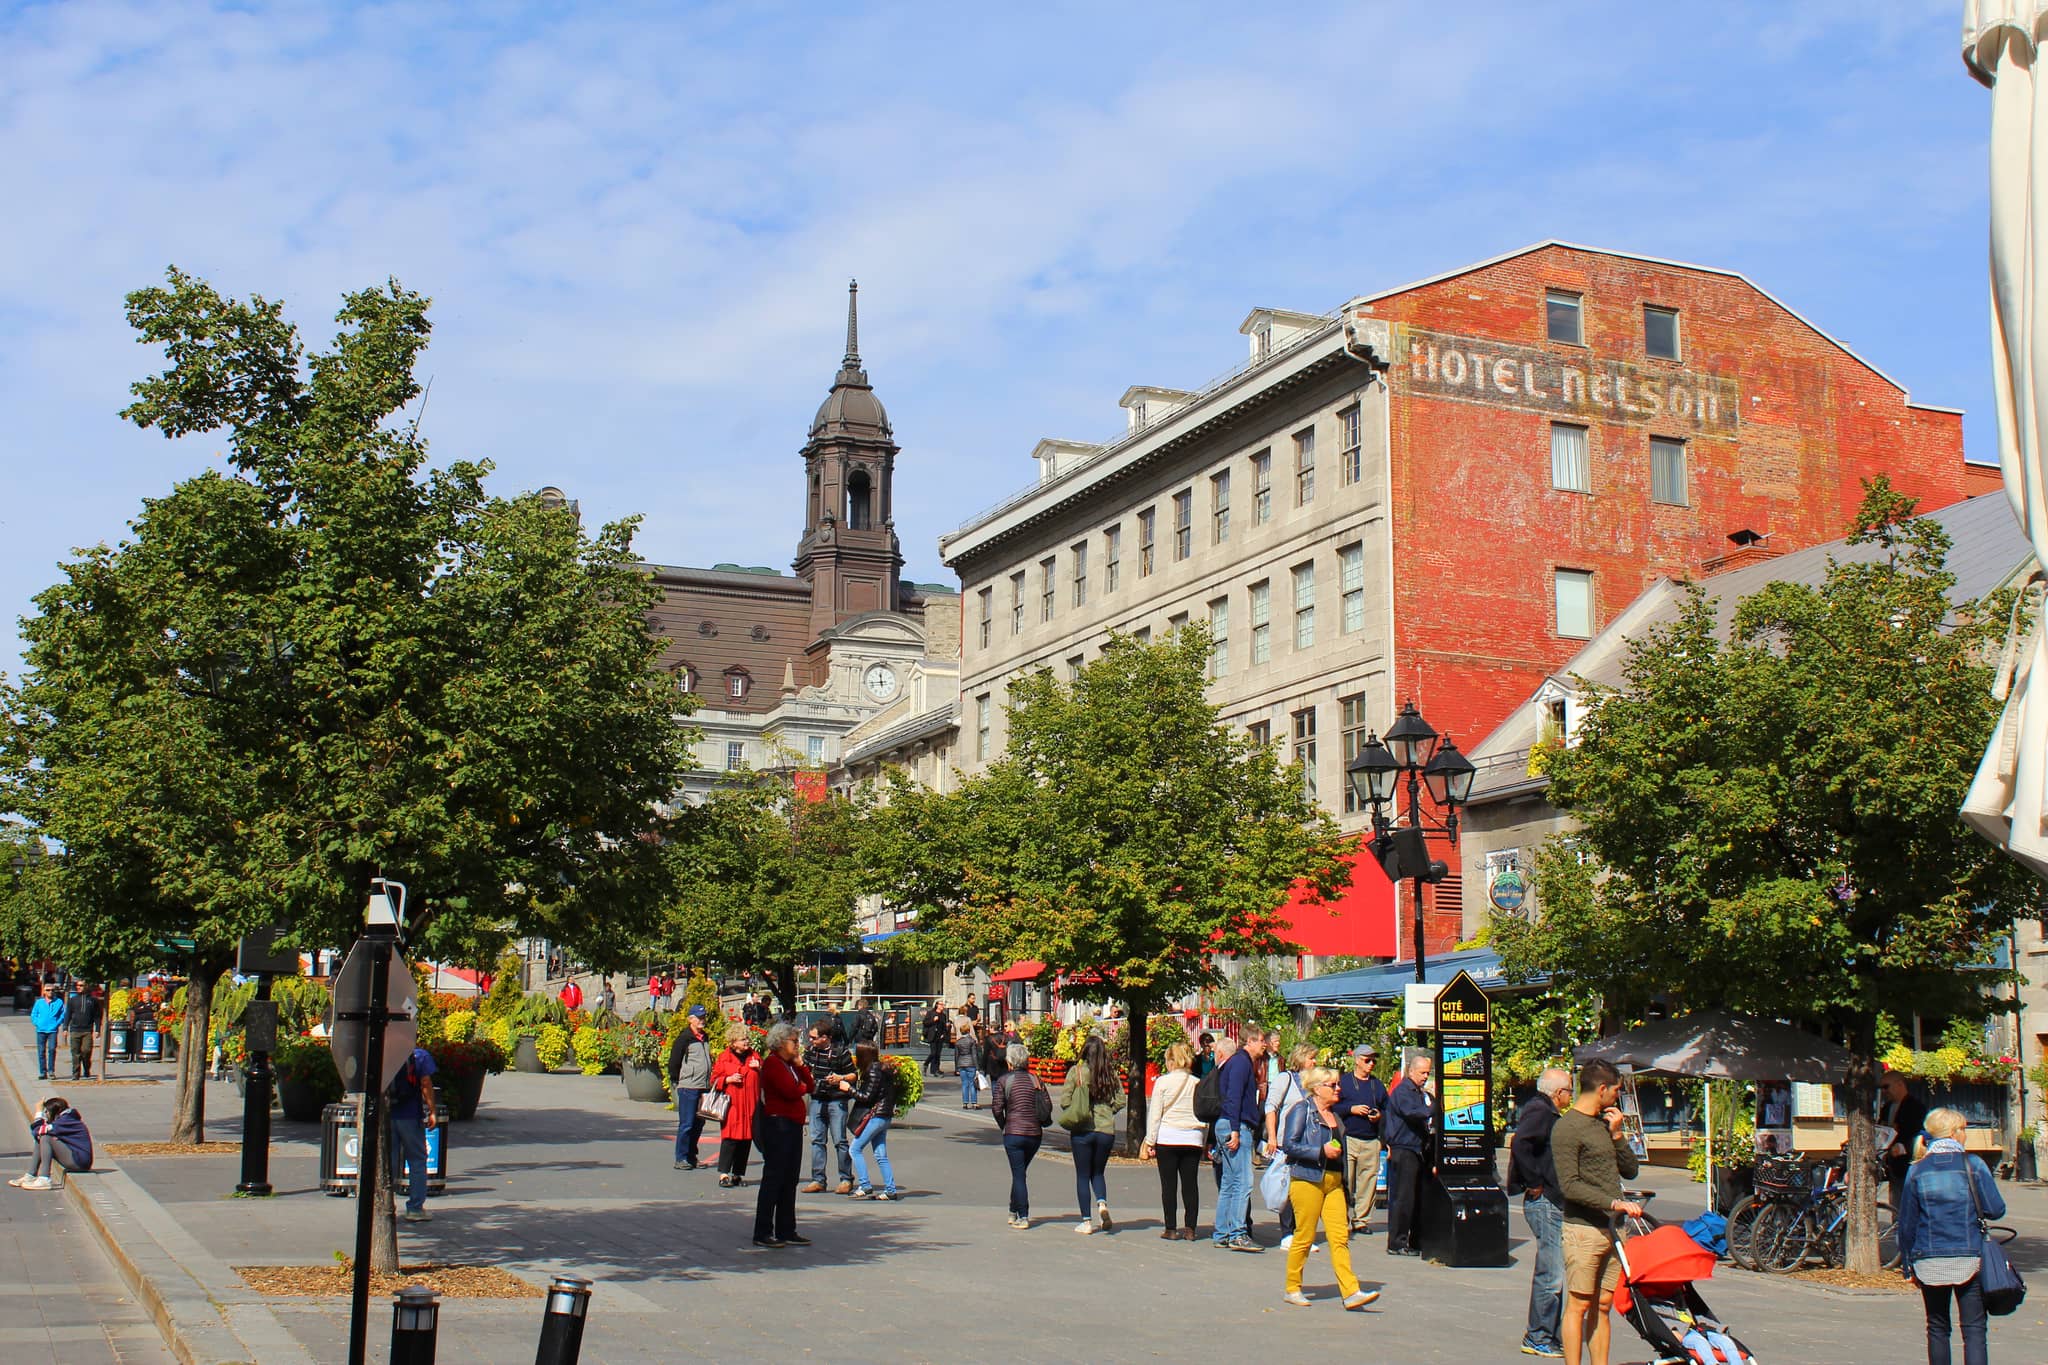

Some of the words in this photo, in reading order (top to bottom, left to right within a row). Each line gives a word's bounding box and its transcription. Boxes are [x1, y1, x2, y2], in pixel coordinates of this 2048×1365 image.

[1411, 343, 1548, 400] HOTEL
[1561, 366, 1718, 421] NELSON
[1441, 1000, 1463, 1011] CITÉ
[1441, 1011, 1486, 1023] MÉMOIRE
